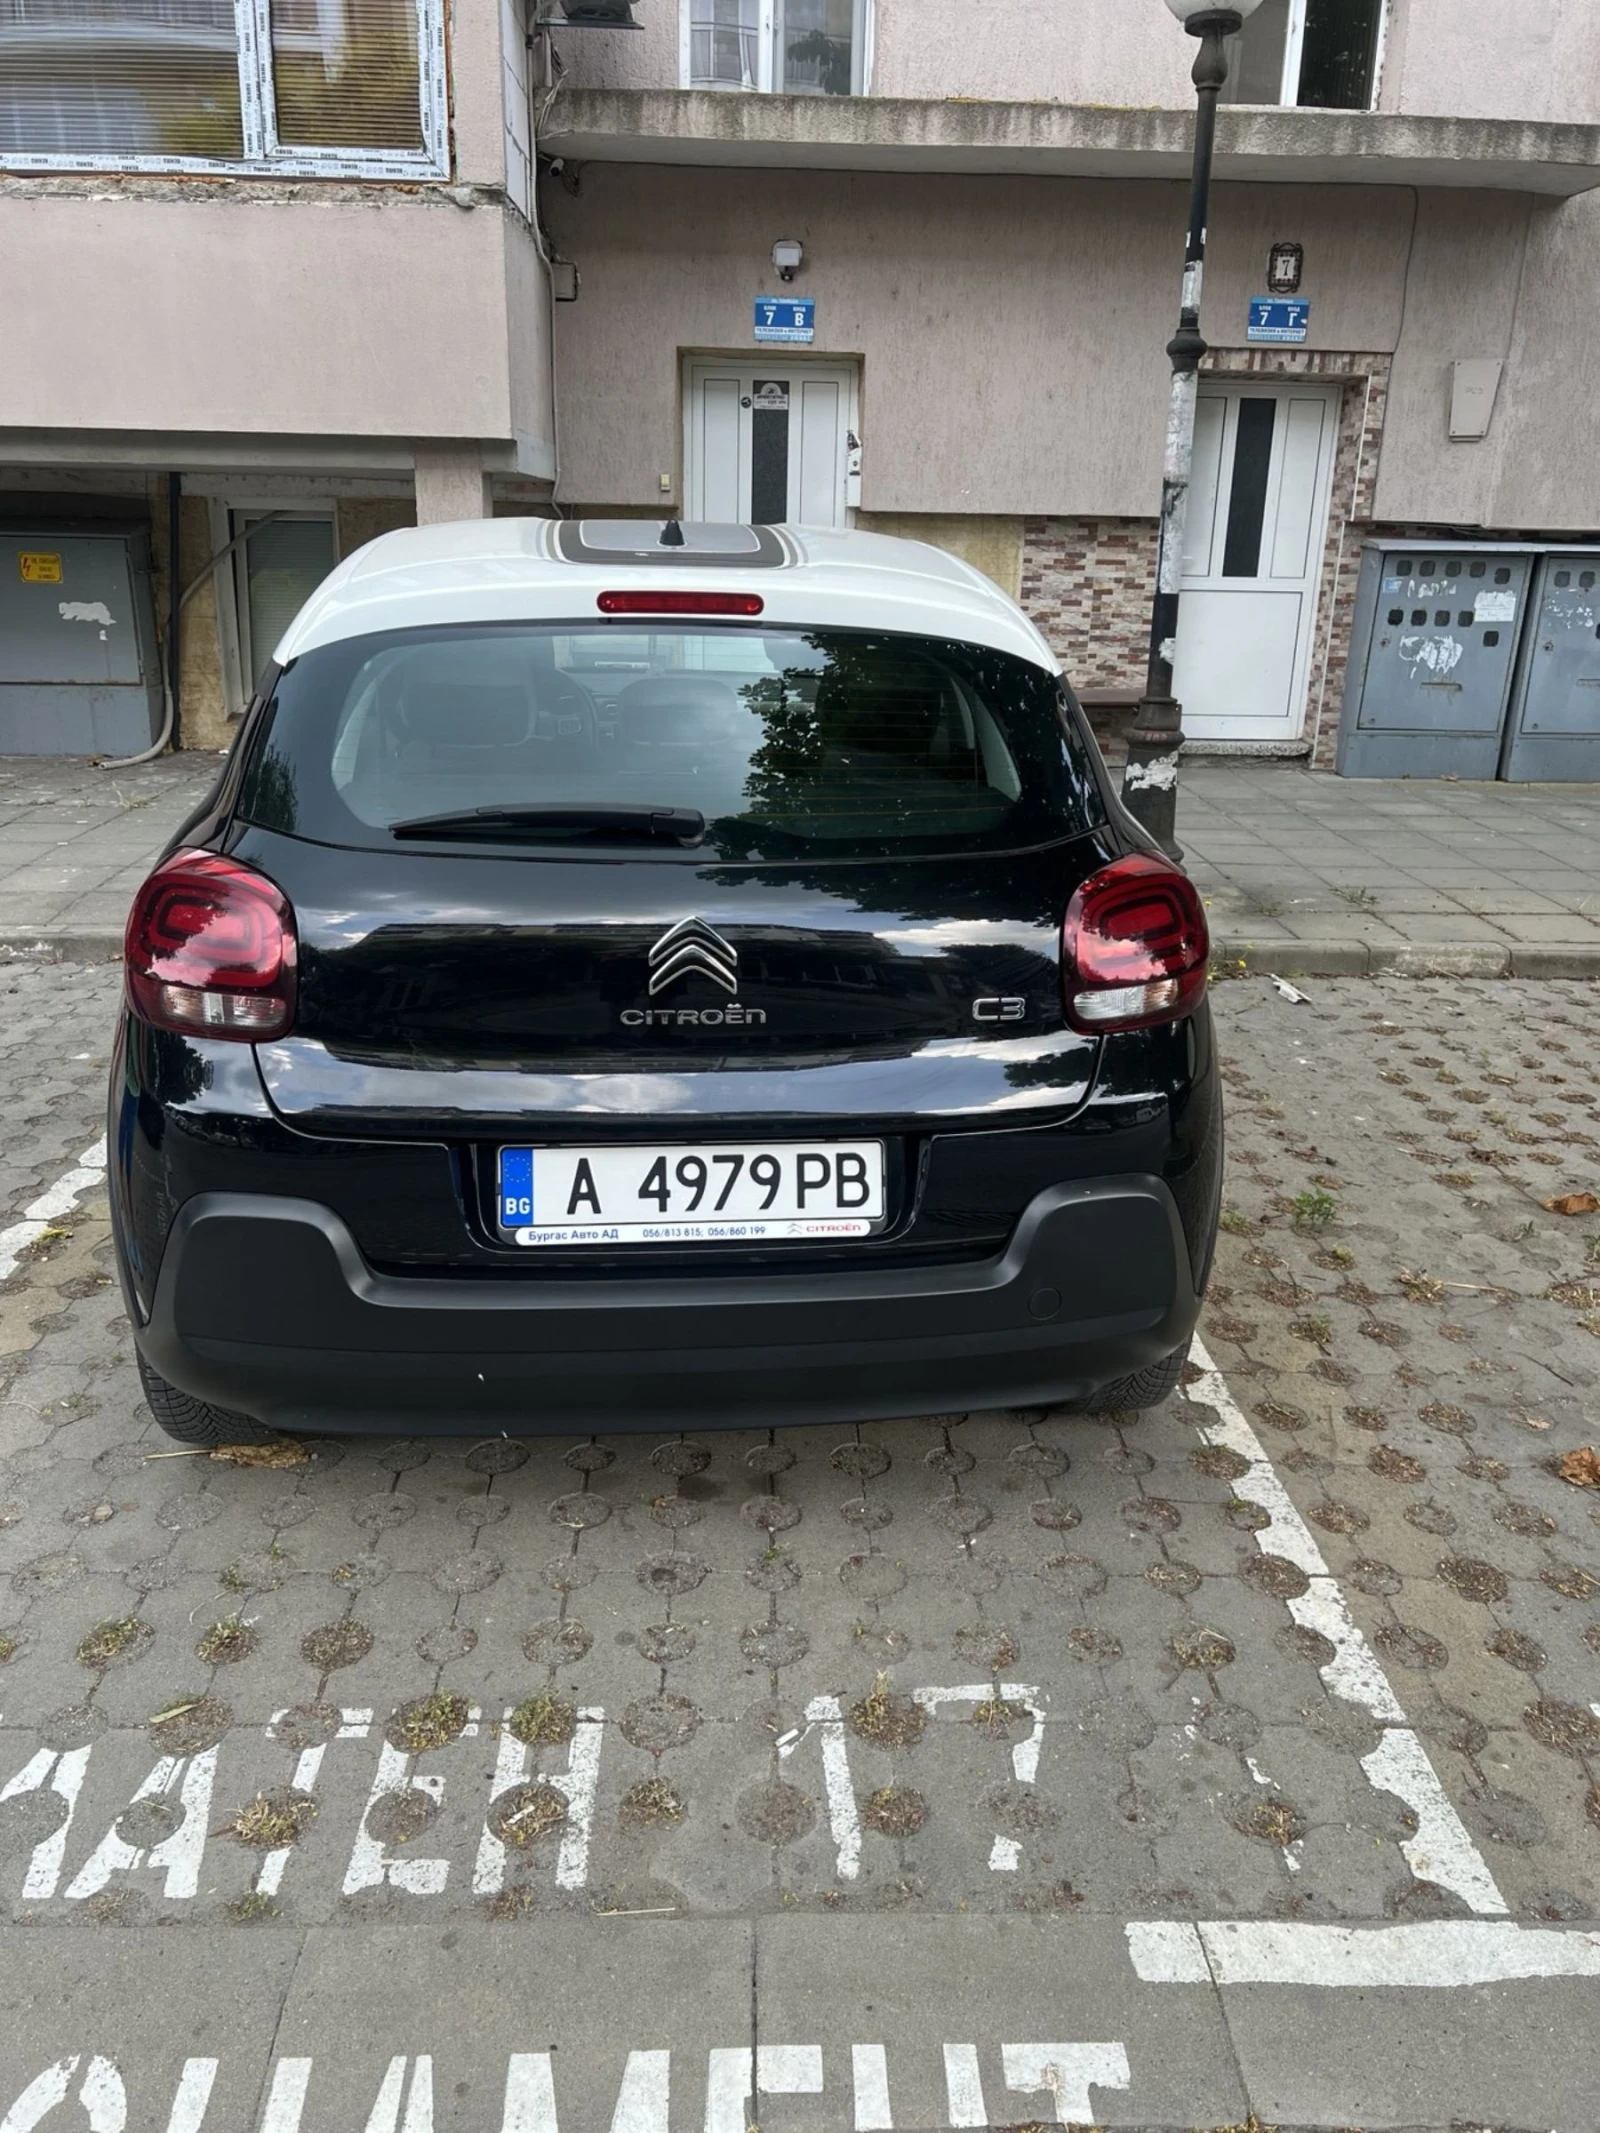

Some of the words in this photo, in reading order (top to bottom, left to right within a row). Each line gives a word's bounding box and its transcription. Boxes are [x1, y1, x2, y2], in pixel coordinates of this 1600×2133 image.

[1282, 259, 1290, 276] 7
[765, 311, 774, 326] 7
[794, 312, 804, 327] В
[1260, 312, 1269, 326] 7
[1288, 312, 1298, 327] Г
[619, 1003, 767, 1026] CITROËN
[972, 997, 1026, 1021] C3
[566, 1157, 602, 1215] A
[505, 1197, 532, 1216] BG
[528, 1230, 568, 1243] Бургас
[571, 1230, 599, 1240] Авто
[601, 1229, 620, 1240] АД
[643, 1228, 682, 1238] 056/813
[708, 1227, 747, 1237] 056/860
[750, 1226, 767, 1236] 199
